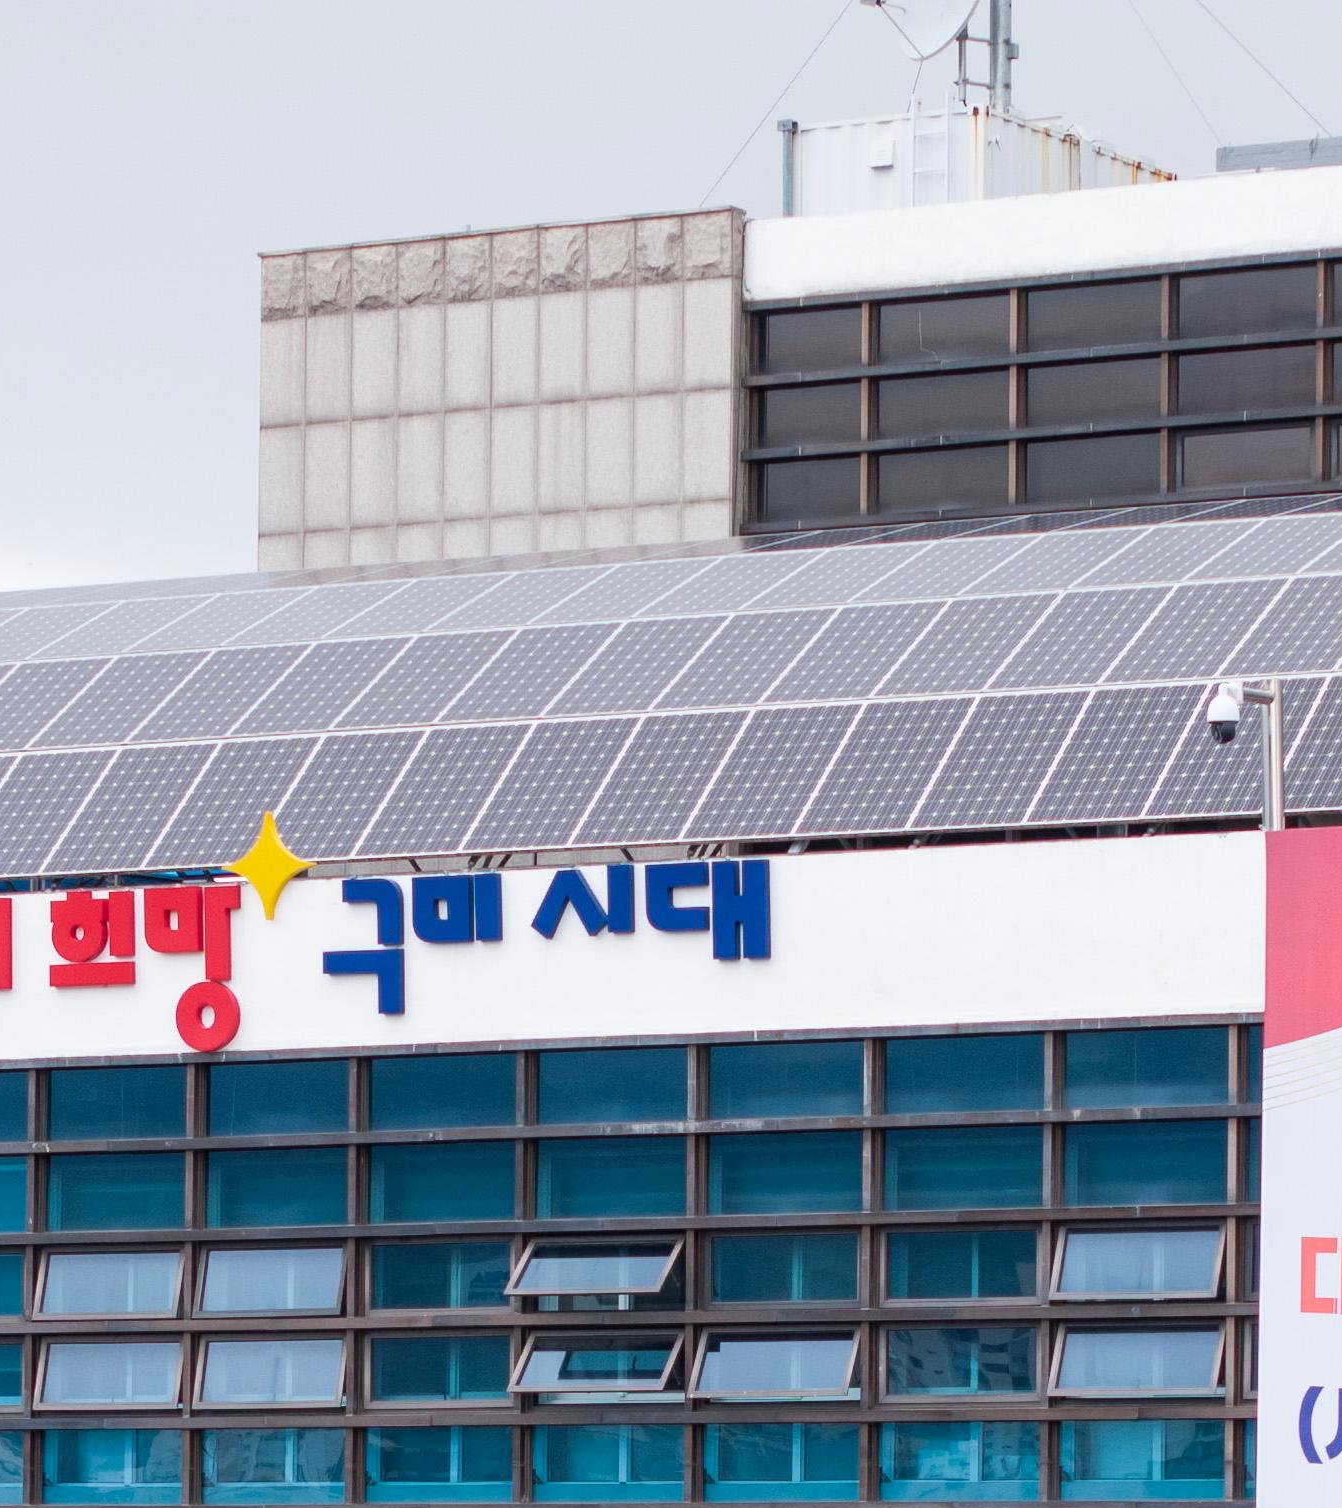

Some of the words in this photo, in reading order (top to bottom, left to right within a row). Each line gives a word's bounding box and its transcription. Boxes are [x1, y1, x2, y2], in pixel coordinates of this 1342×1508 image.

[50, 884, 242, 1052] 희망
[323, 873, 505, 1015] 구미
[531, 859, 771, 961] 시대
